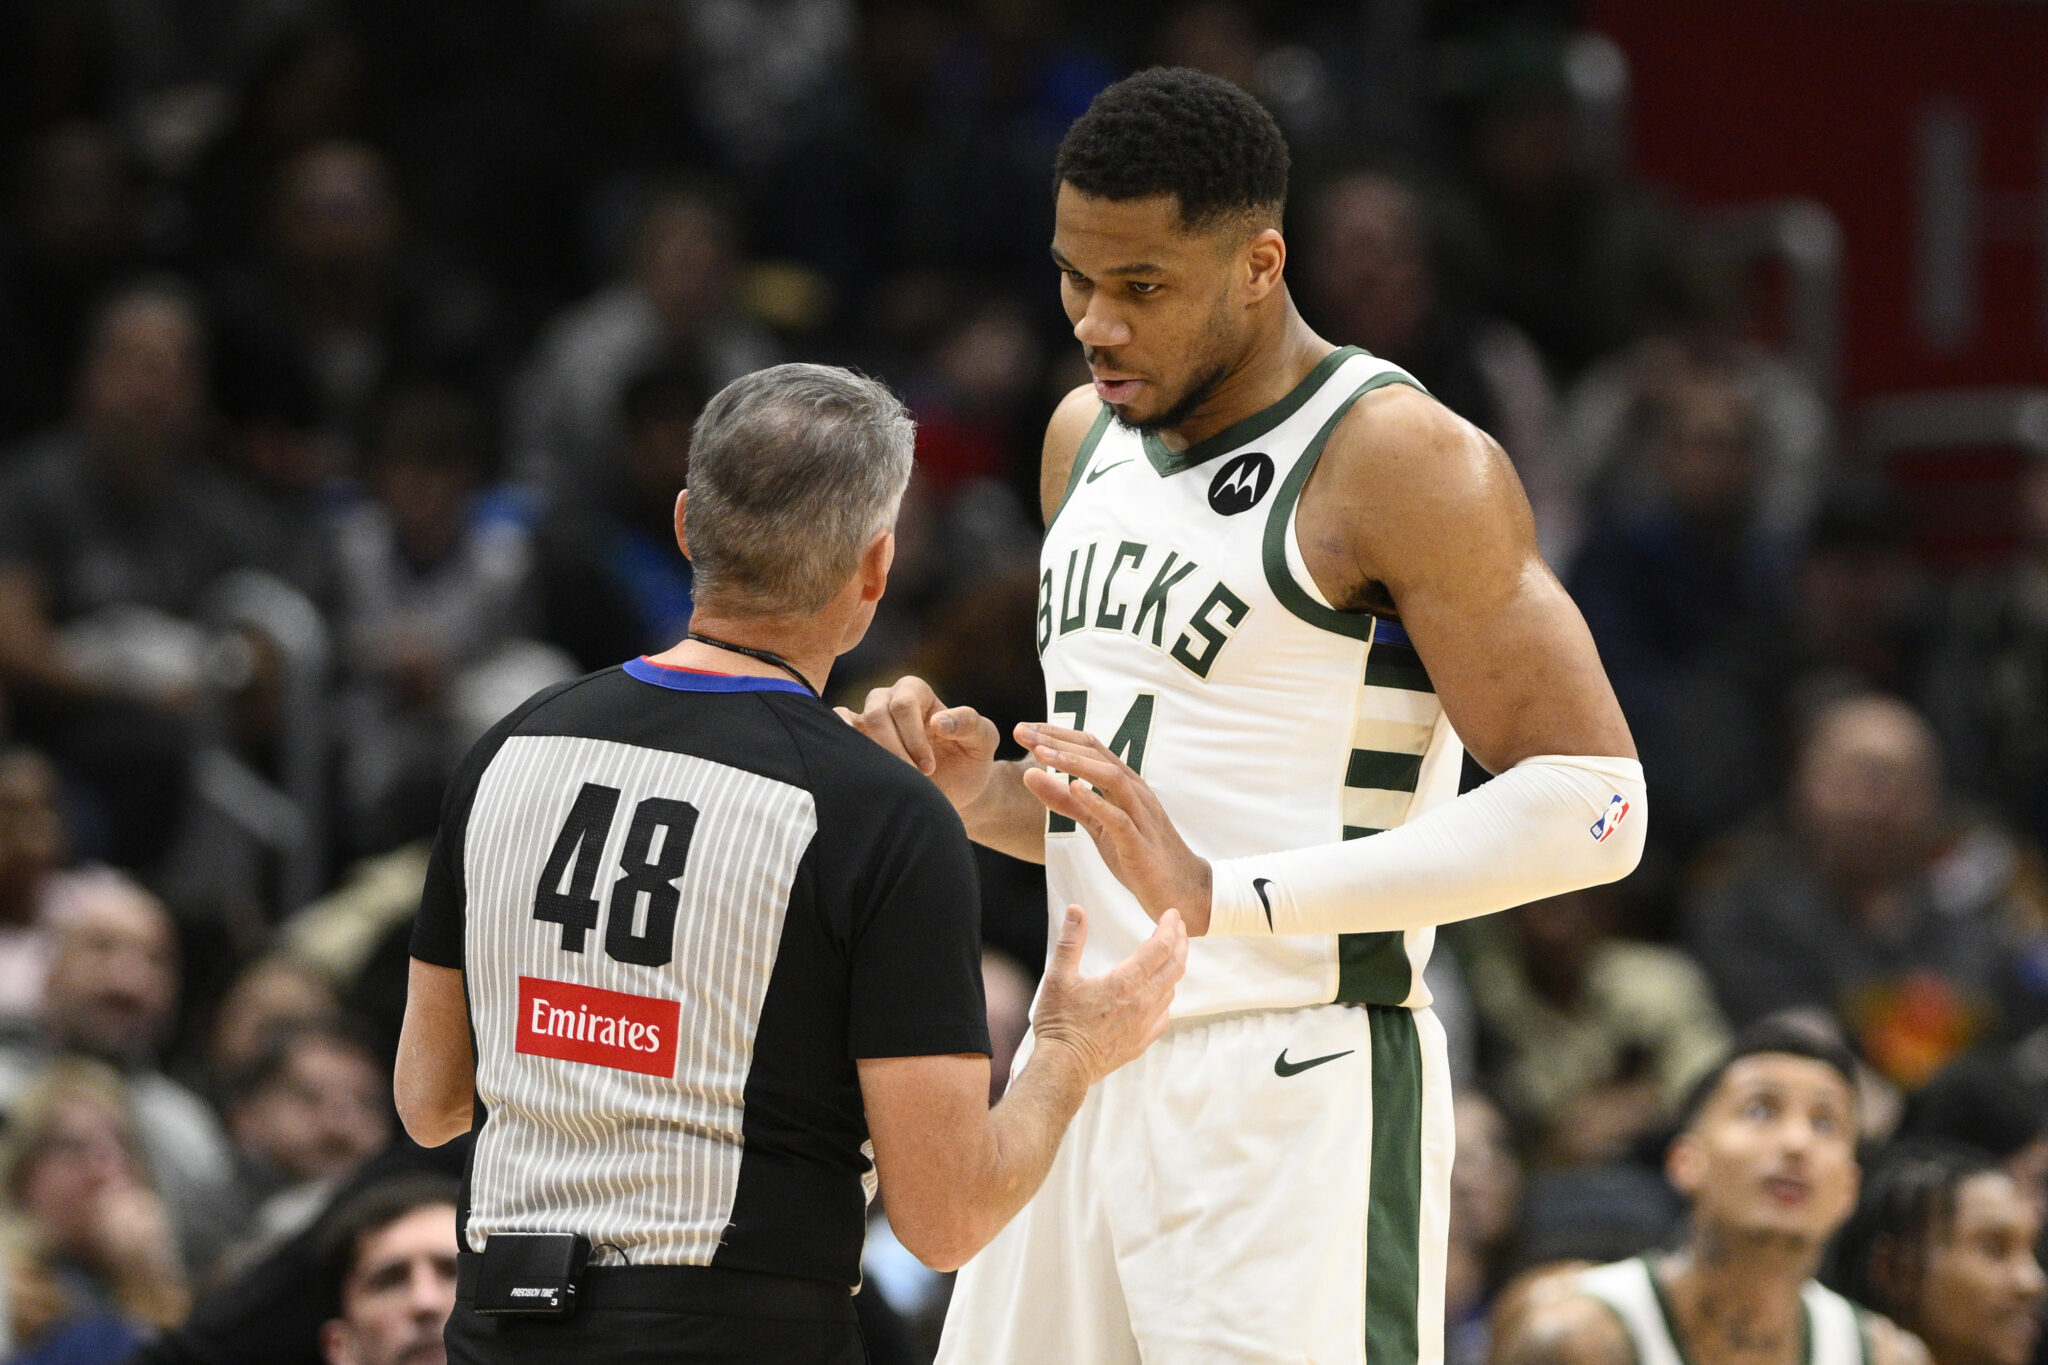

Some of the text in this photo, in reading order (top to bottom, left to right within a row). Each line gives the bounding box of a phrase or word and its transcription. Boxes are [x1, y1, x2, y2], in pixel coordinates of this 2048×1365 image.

[1038, 541, 1251, 679] BUCKS
[533, 782, 700, 967] 48
[531, 997, 660, 1053] Emirates
[550, 1298, 558, 1306] 3
